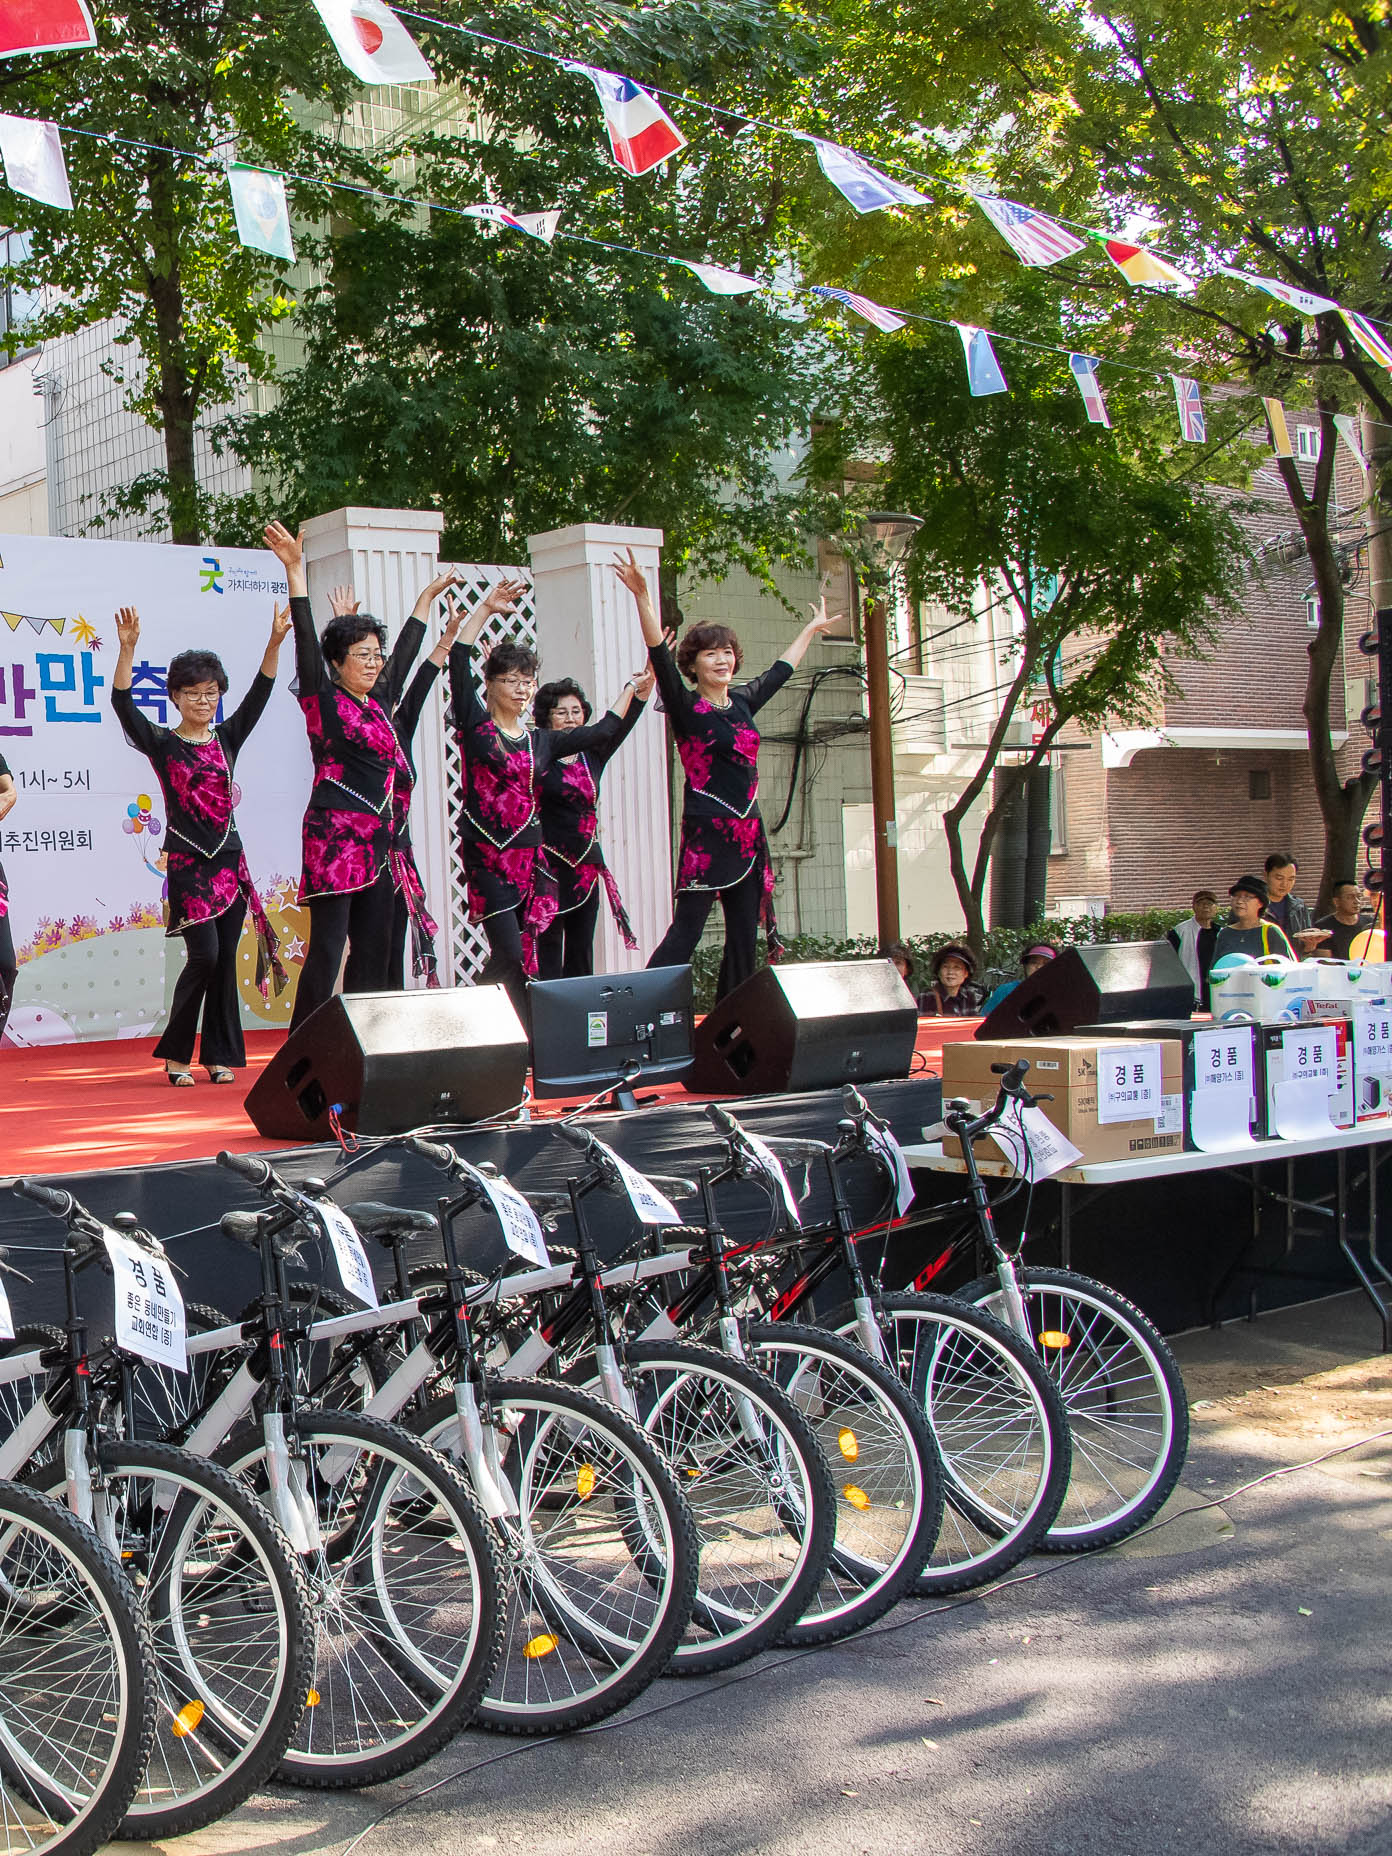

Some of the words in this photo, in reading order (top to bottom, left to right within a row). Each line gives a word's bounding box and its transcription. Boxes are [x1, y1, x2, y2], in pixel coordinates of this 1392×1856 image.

[228, 579, 269, 593] 가치더하기
[270, 581, 288, 595] 광진
[64, 769, 91, 791] 5시
[1315, 1002, 1338, 1010] Tefal
[127, 1291, 141, 1313] 좋은
[144, 1299, 177, 1328] 동네만들기
[131, 1315, 159, 1341] 교회연합
